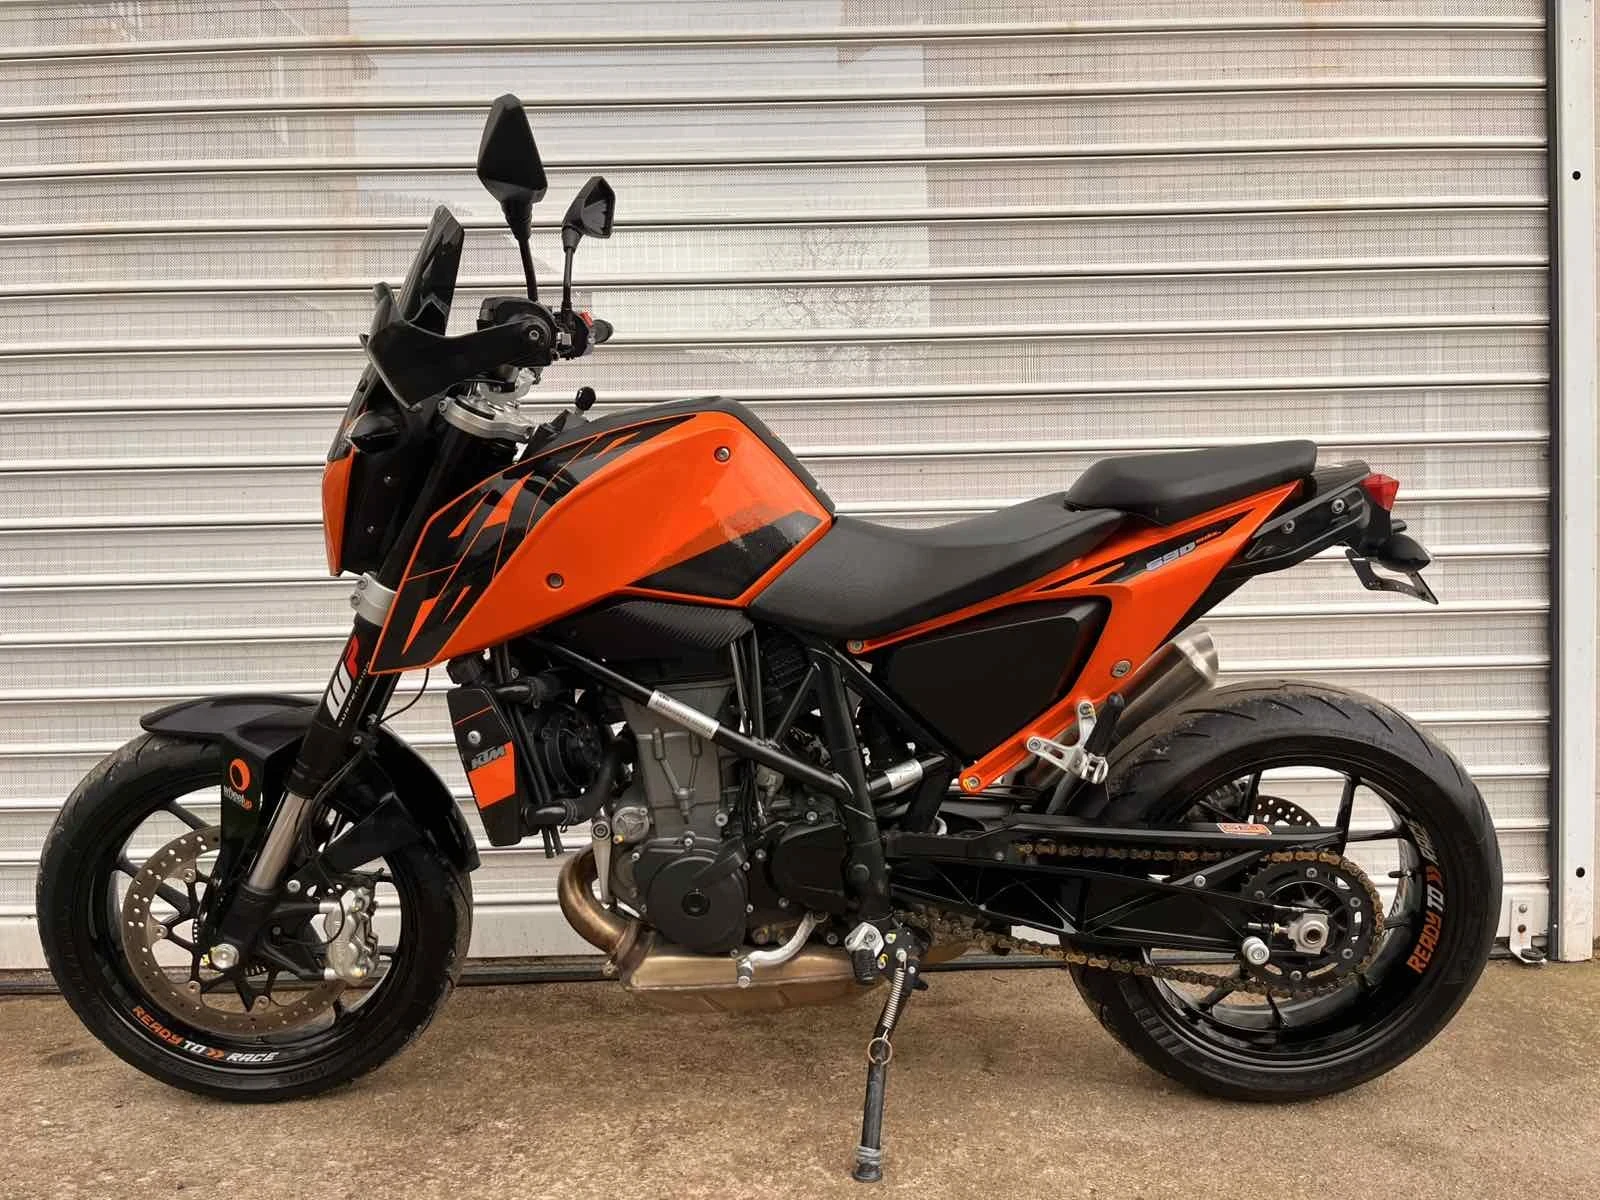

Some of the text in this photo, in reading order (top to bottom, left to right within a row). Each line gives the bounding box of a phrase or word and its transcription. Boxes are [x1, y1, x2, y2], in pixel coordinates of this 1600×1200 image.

[471, 746, 505, 769] KTM
[1406, 912, 1442, 973] READY
[1426, 884, 1444, 912] TO
[132, 1006, 280, 1064] READY TO RACE
